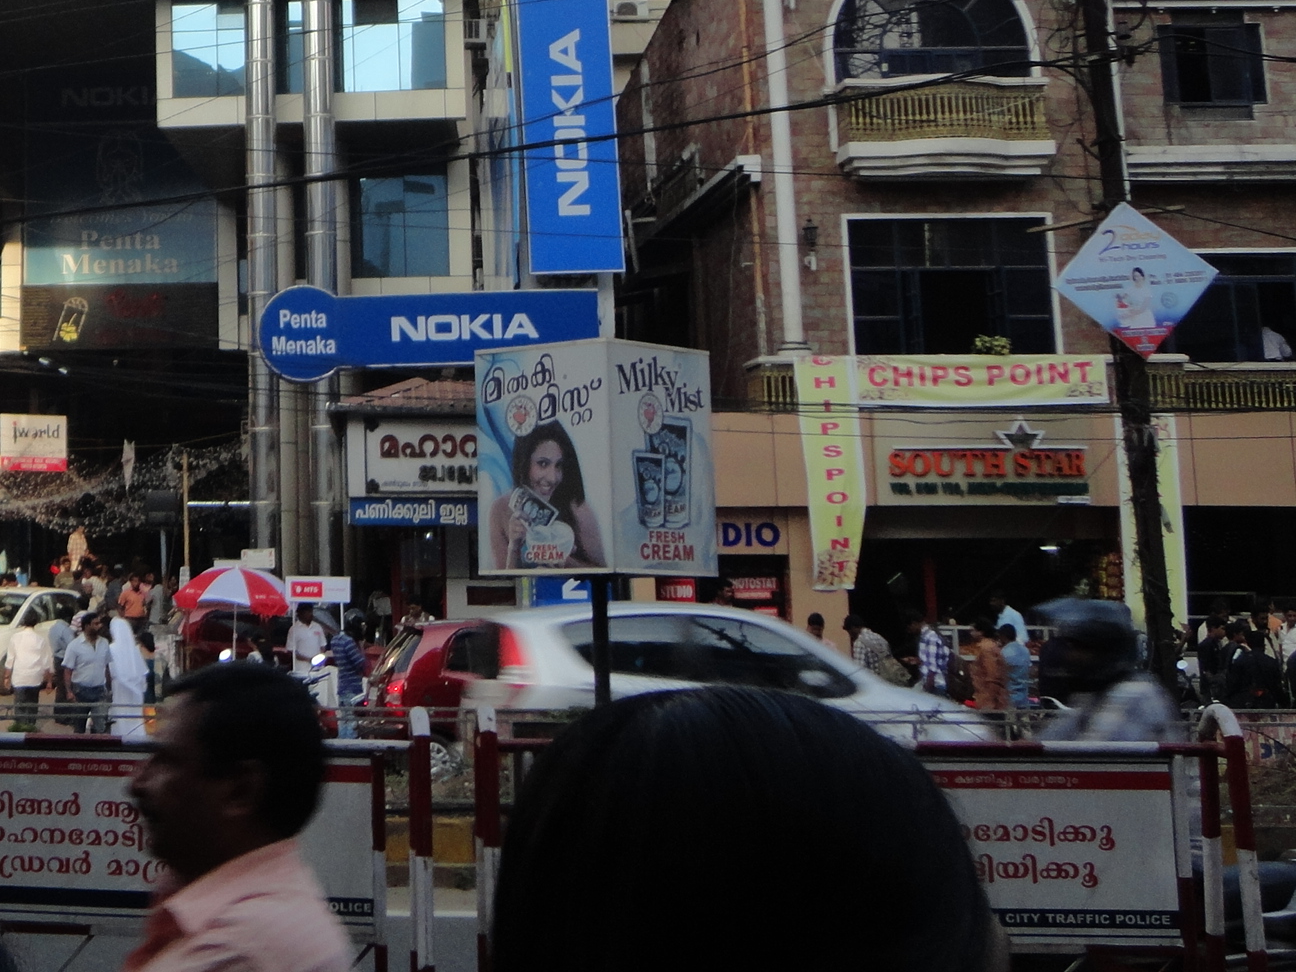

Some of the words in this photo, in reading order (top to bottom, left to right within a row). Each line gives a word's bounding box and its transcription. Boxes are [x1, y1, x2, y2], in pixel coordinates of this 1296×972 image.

[61, 87, 152, 107] NOKI
[549, 28, 591, 217] NOKIA
[81, 230, 161, 251] Penta
[60, 253, 179, 276] Menaka
[279, 309, 327, 328] Penta
[390, 313, 539, 342] NOKIA
[271, 334, 336, 355] Menaka
[615, 356, 679, 397] Milky
[868, 363, 975, 389] CHIPS
[987, 361, 1094, 387] POINT
[663, 382, 705, 413] Mist
[888, 450, 1008, 477] SOUTH
[1014, 450, 1087, 477] STAR
[439, 503, 468, 525] ഇല്ല
[649, 530, 685, 544] FRESH
[525, 551, 565, 561] CREAM
[640, 543, 695, 562] CREAM
[660, 584, 693, 599] STUDIO
[731, 577, 777, 590] HOTOSTAT
[329, 901, 372, 913] OLICE
[1005, 913, 1041, 925] CITY
[1045, 913, 1110, 926] TRAFFIC
[1115, 914, 1171, 926] POLICE
